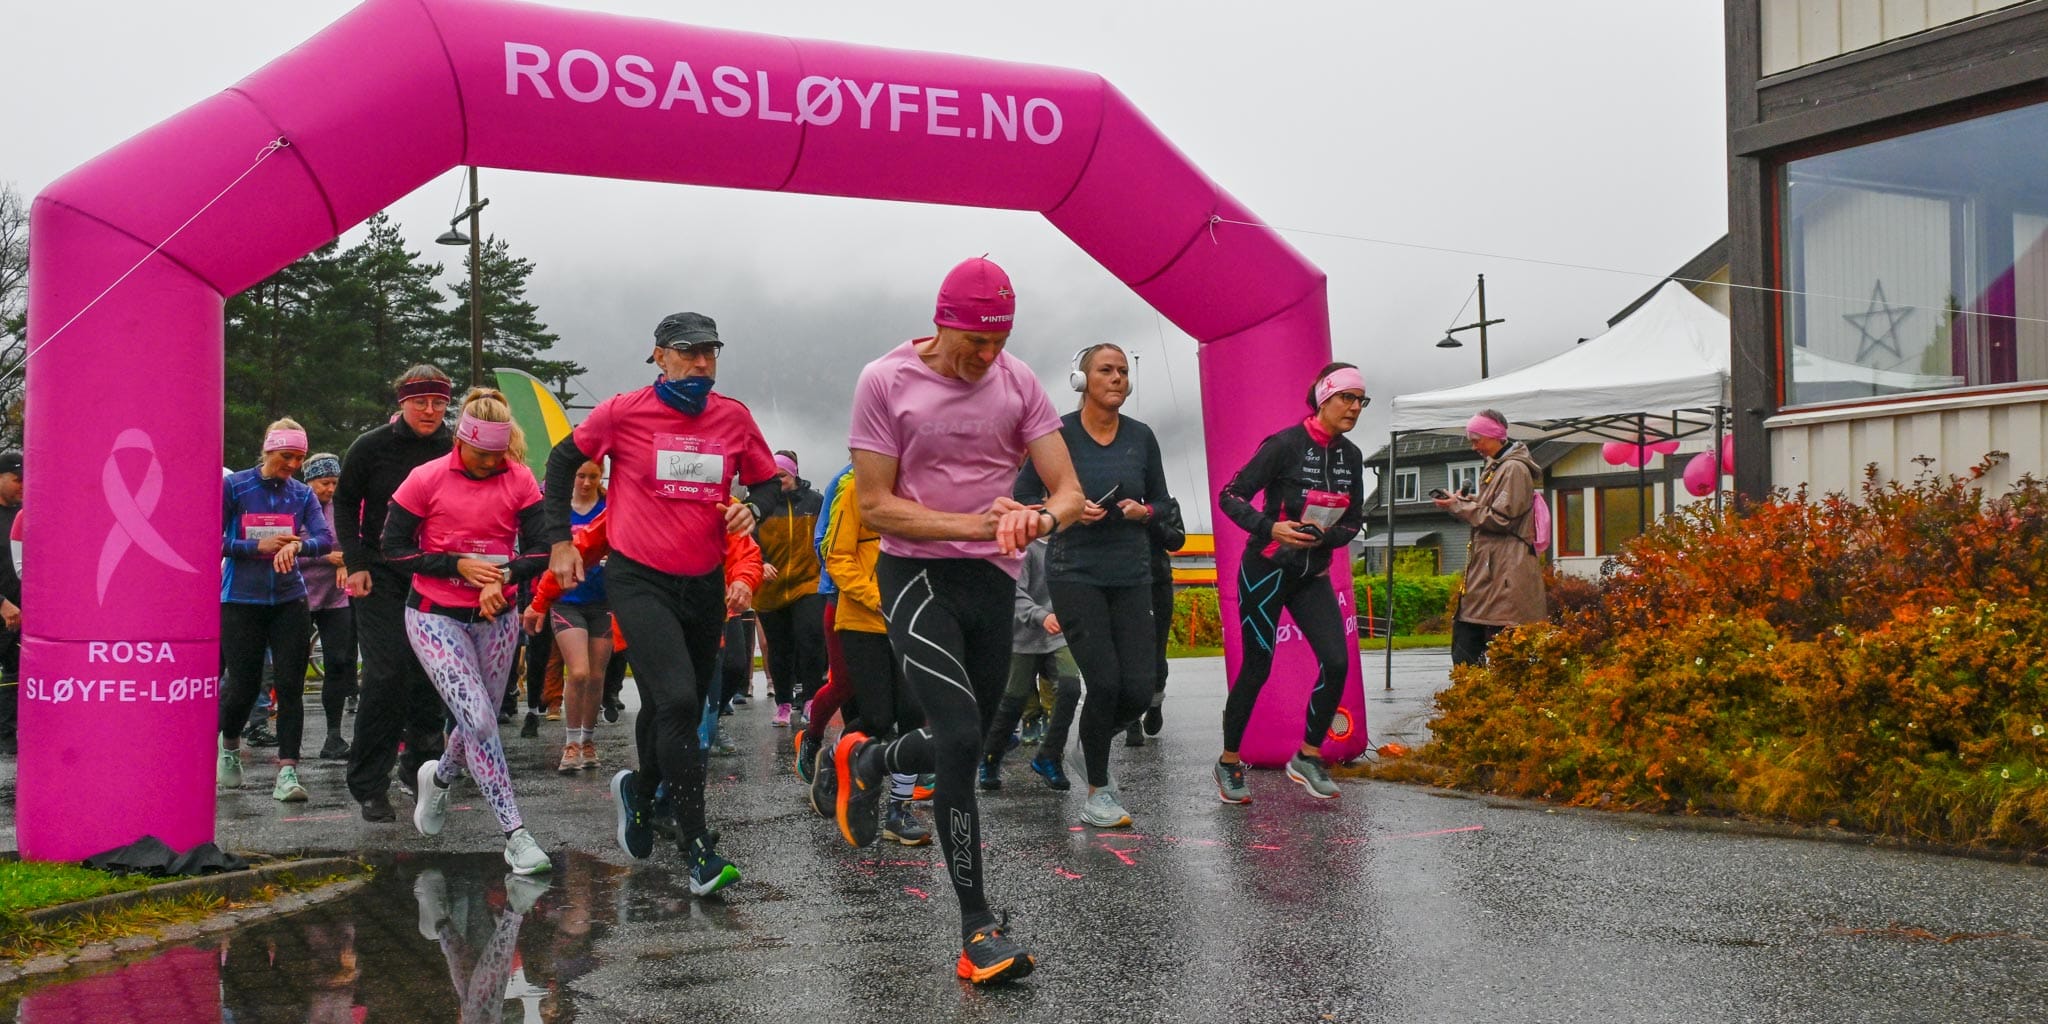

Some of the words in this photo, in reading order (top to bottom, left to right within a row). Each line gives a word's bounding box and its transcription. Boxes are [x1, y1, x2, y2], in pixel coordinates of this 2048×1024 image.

[503, 41, 1064, 146] ROSASLØYFE.NO
[670, 454, 704, 478] Rune
[679, 486, 699, 494] coop
[88, 641, 176, 663] ROSA
[26, 676, 219, 705] SLØYFE-LØPET
[950, 807, 973, 887] 2XU
